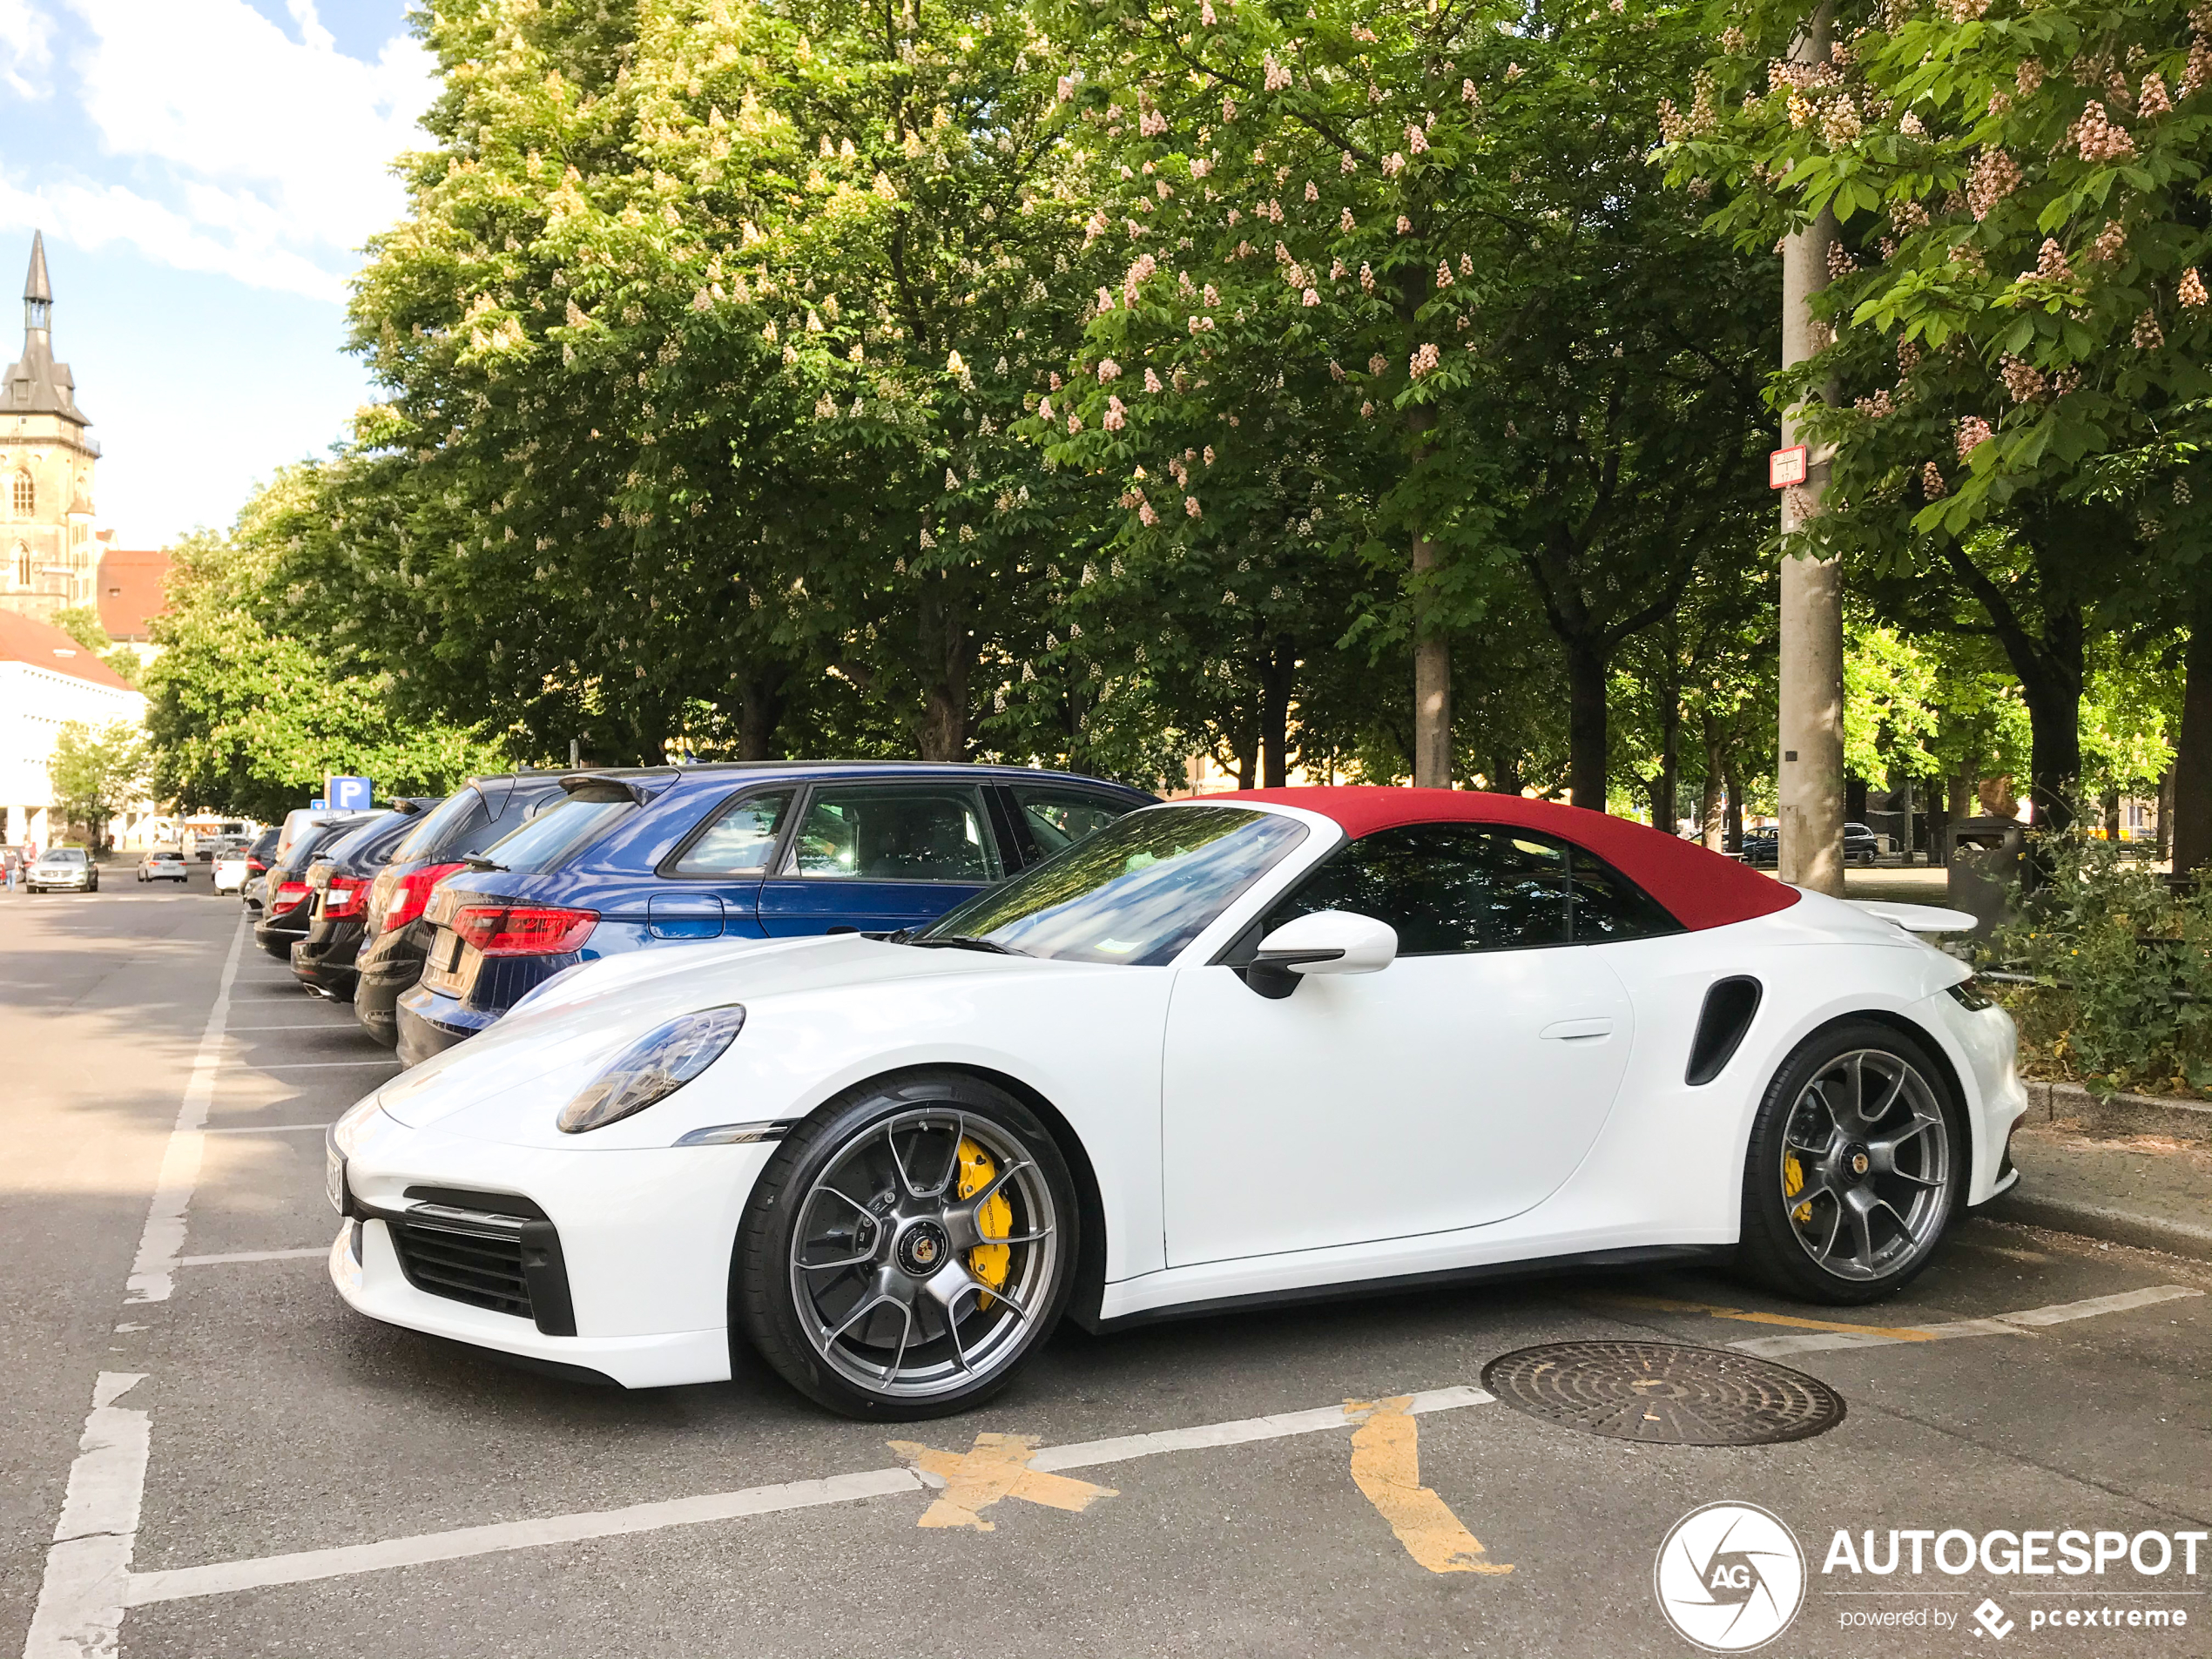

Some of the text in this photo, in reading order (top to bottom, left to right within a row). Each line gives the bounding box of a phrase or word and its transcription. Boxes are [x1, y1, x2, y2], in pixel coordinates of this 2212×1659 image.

[1782, 451, 1794, 462] 300
[341, 781, 361, 807] P
[987, 1197, 999, 1252] PORSCE
